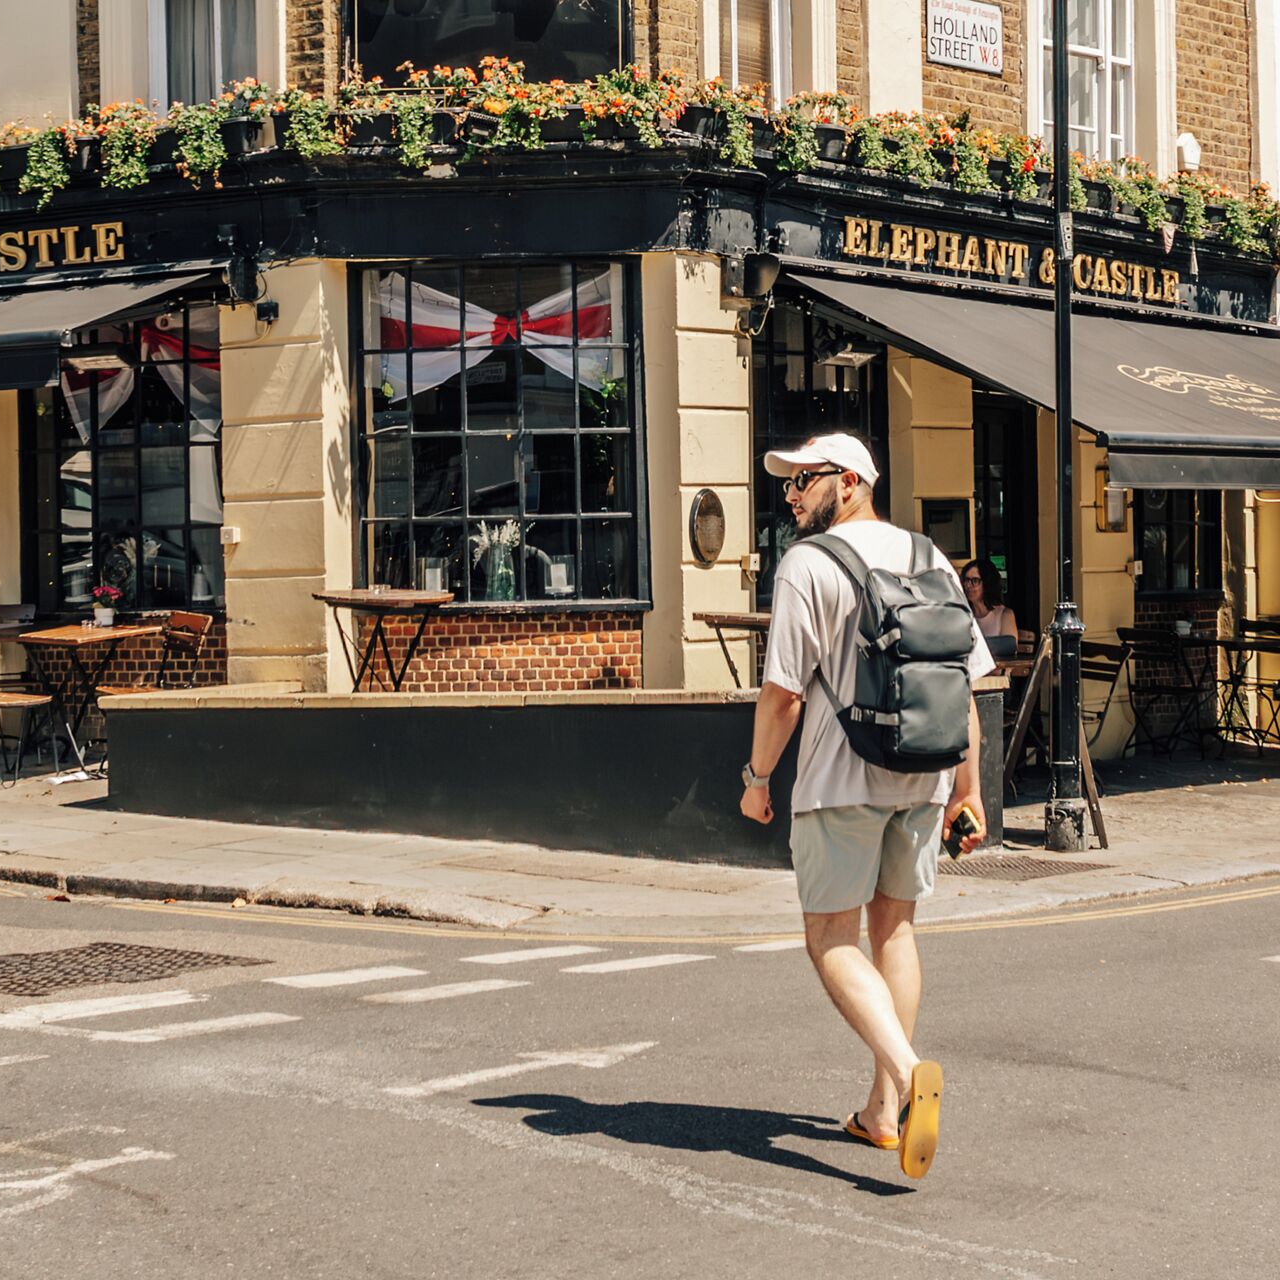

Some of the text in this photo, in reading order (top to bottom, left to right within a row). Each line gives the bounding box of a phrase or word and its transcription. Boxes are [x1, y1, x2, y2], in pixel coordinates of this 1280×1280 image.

[933, 15, 998, 45] HOLLAND
[843, 216, 1180, 303] ELEPHANT & CASTLE
